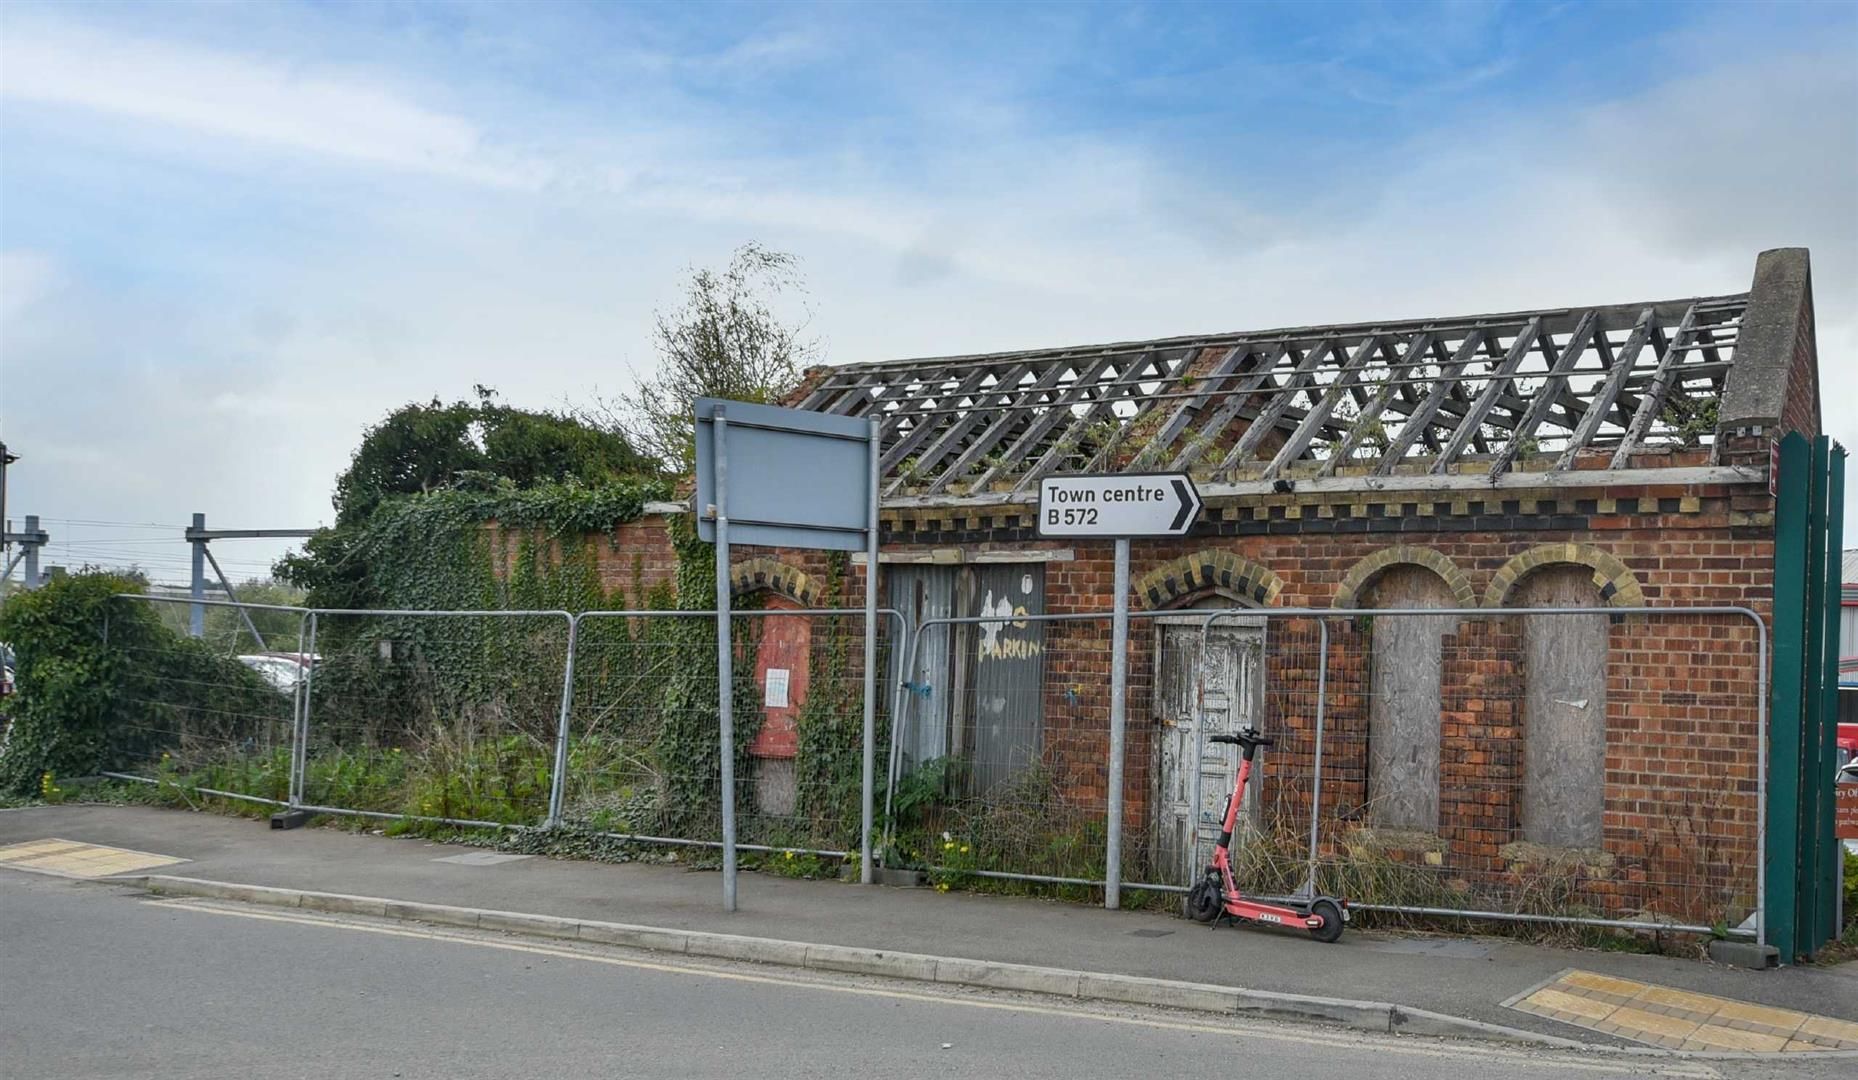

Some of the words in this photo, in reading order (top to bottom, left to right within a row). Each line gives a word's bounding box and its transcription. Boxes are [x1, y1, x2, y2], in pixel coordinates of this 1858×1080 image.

[1048, 486, 1095, 503] Town
[1102, 485, 1165, 502] centre
[1048, 509, 1060, 525] B
[1064, 508, 1098, 525] 572
